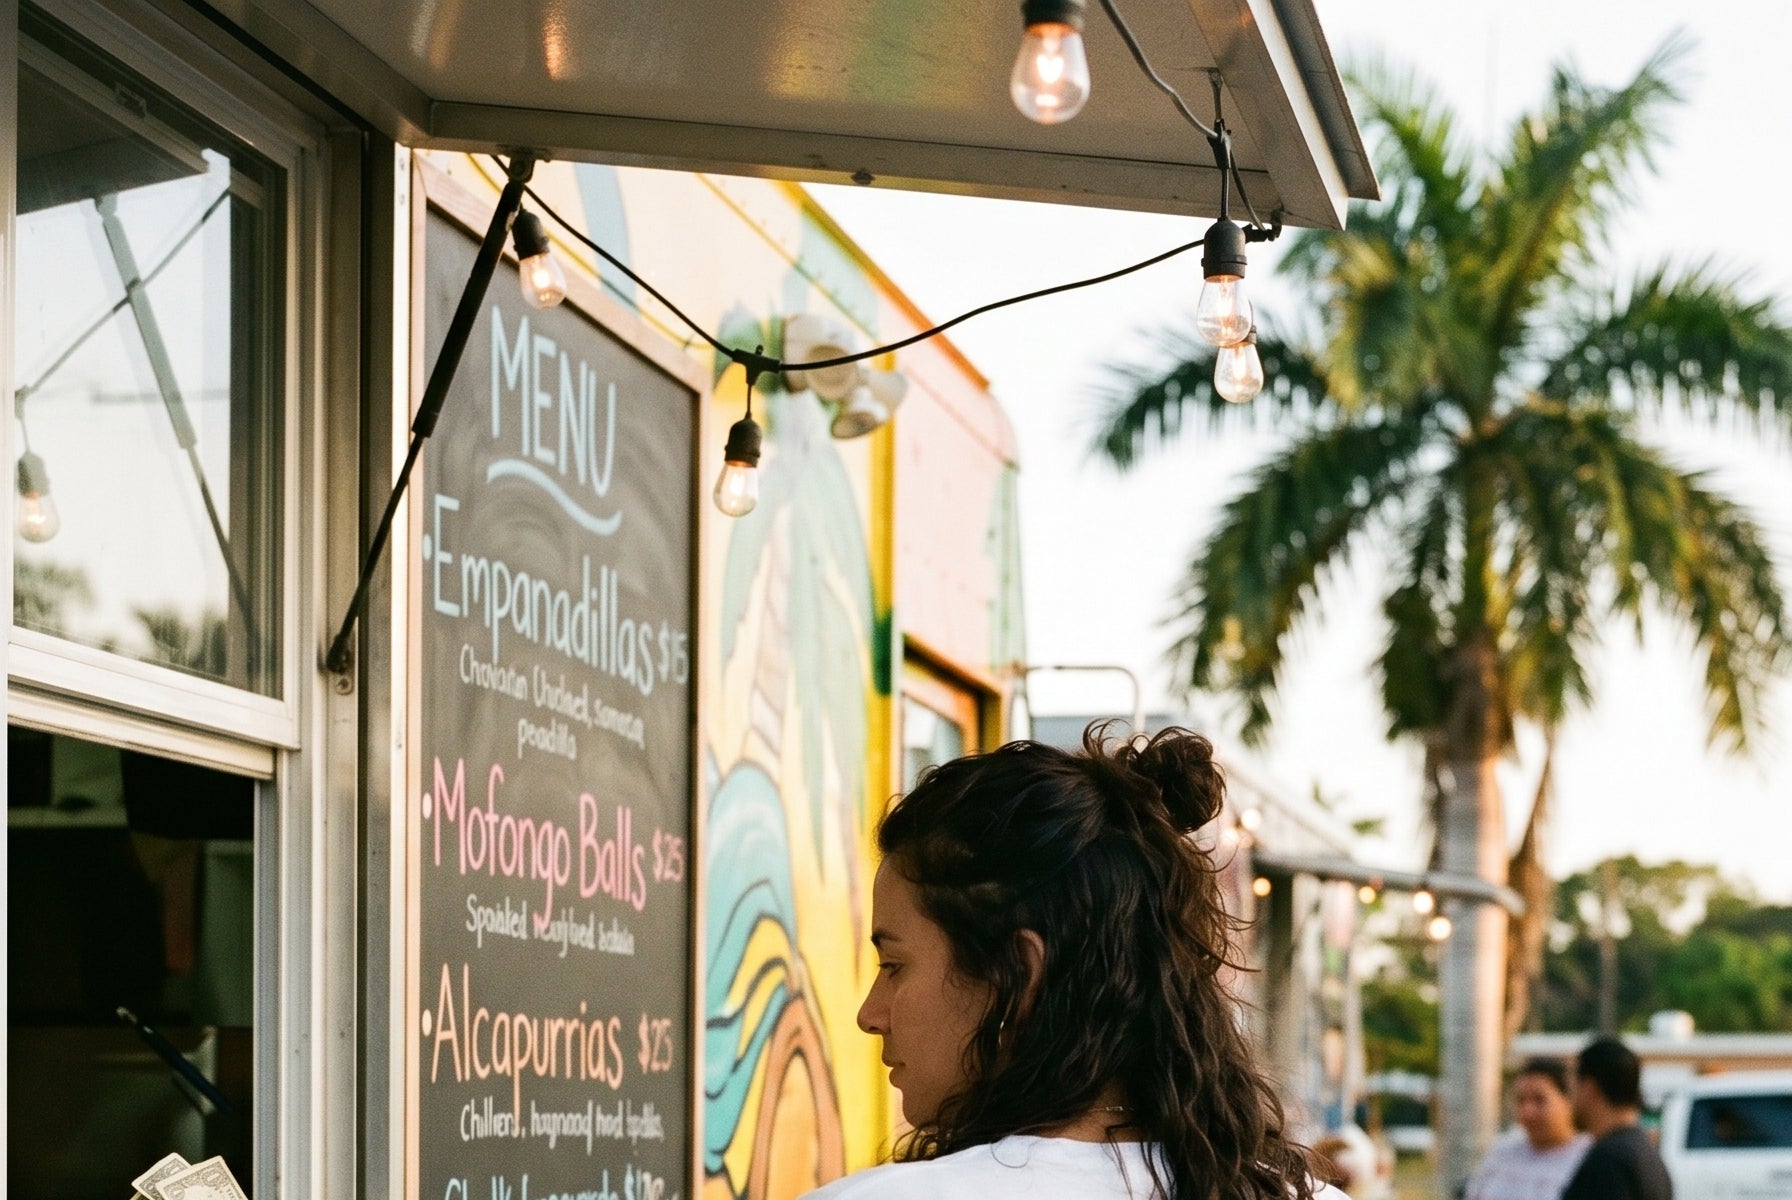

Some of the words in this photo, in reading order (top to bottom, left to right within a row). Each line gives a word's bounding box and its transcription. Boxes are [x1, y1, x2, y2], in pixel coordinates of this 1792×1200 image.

[491, 303, 617, 498] MENU
[434, 493, 654, 696] Empanadillas
[433, 755, 571, 931] Mofongo
[579, 791, 648, 912] Balls
[431, 961, 624, 1138] Alcapurrias
